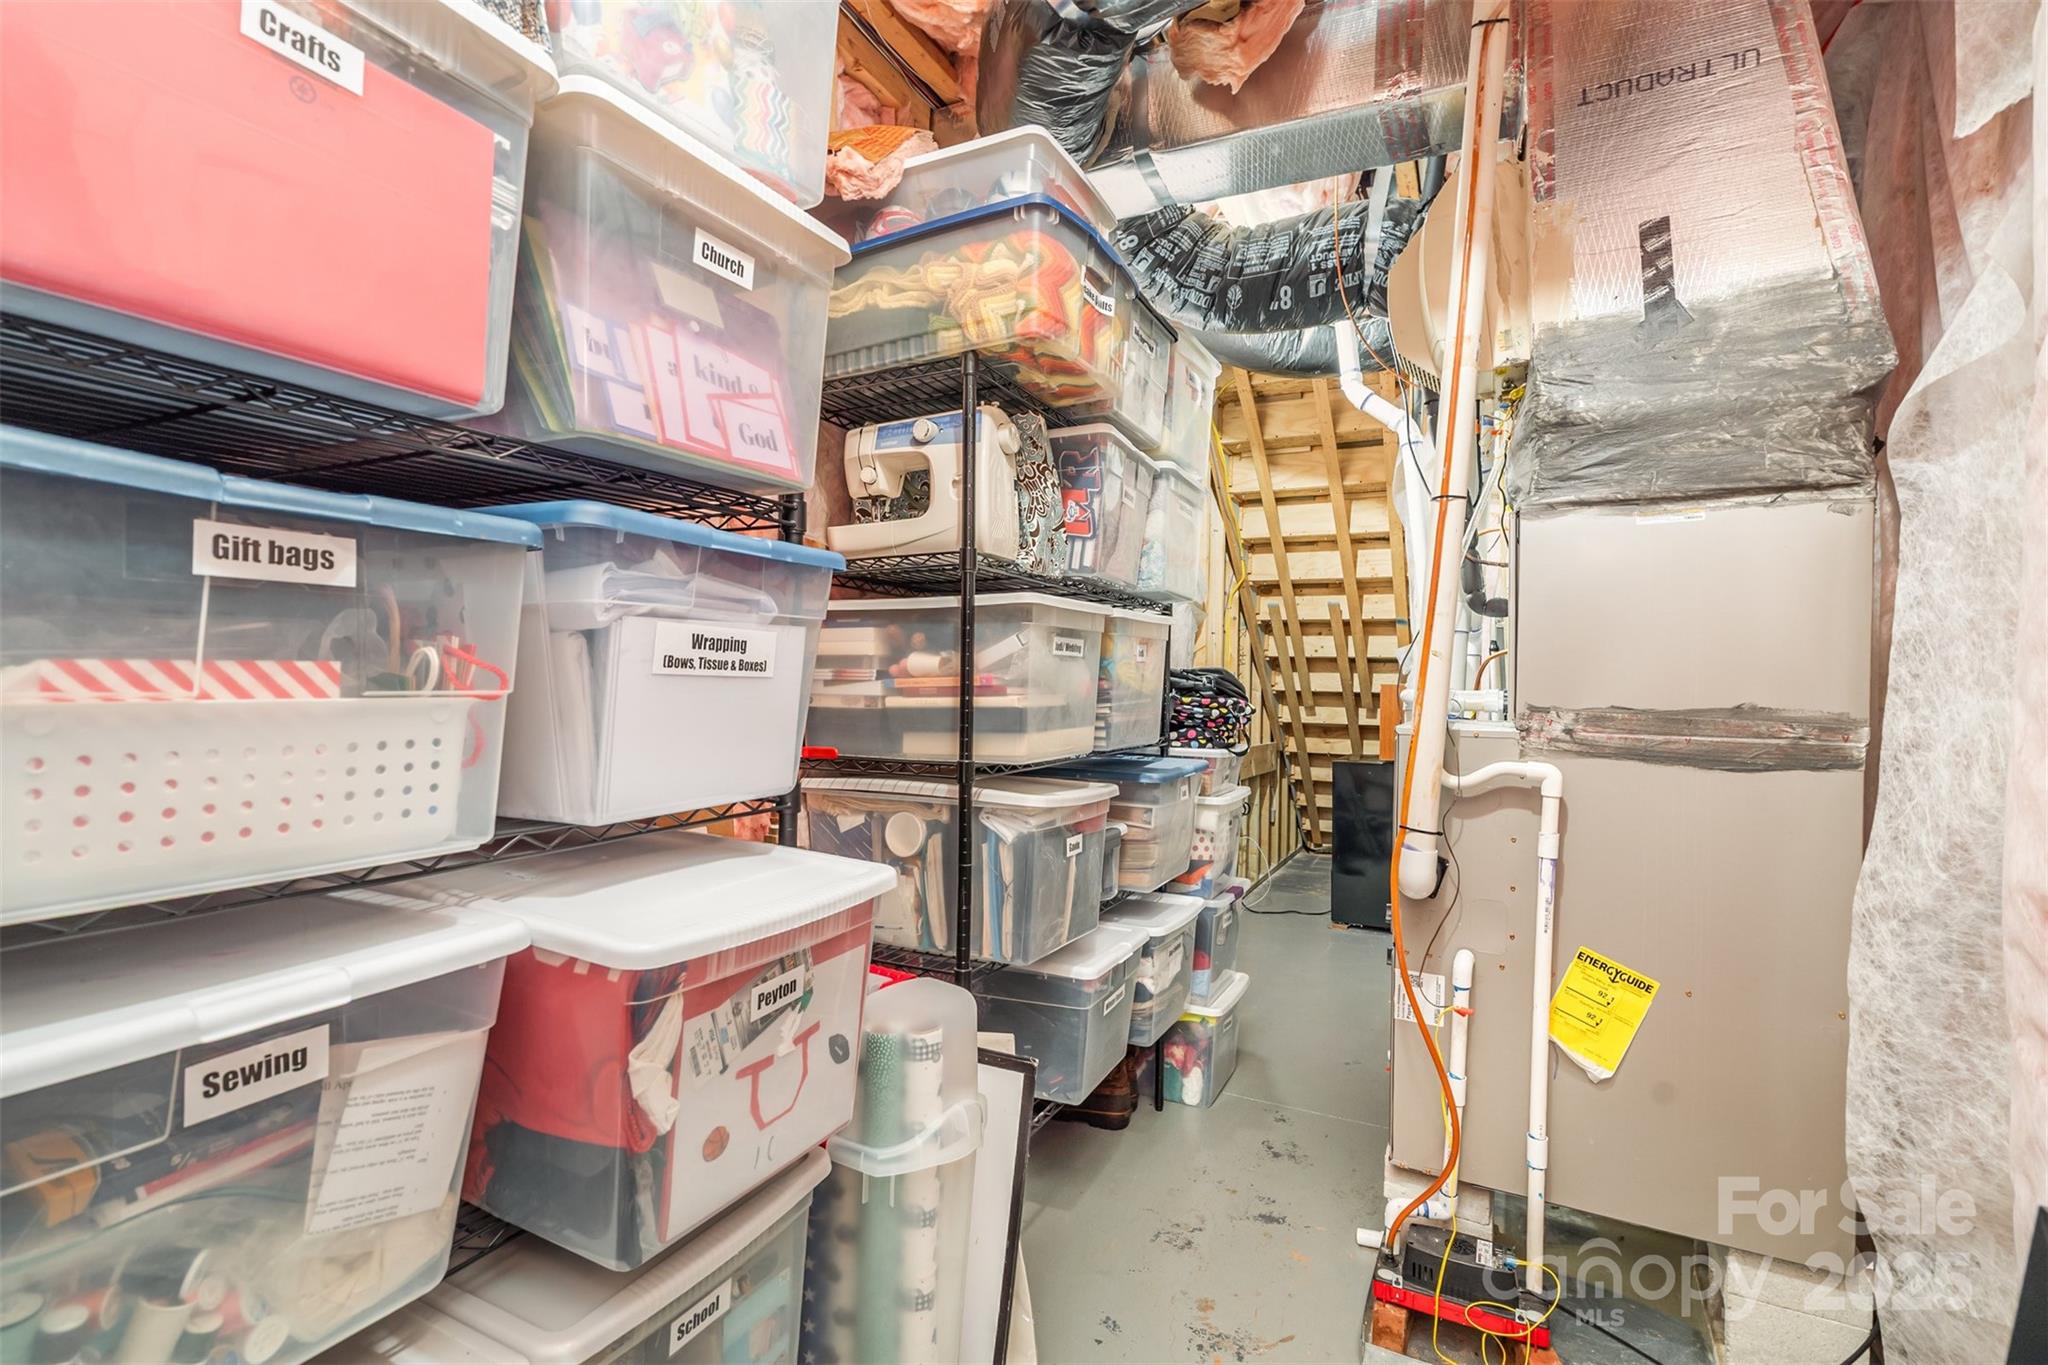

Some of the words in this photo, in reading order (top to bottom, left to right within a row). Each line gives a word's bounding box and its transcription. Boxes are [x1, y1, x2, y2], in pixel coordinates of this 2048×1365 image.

[260, 8, 341, 72] Crafts
[1577, 48, 1761, 107] ULTRADUCT
[702, 241, 745, 278] Church
[1270, 285, 1292, 311] 8"
[738, 422, 779, 453] God
[212, 533, 261, 564] Gift
[268, 540, 335, 572] bags
[691, 633, 748, 655] Wrapping
[663, 654, 697, 671] (Bows,
[698, 656, 730, 671] Tissue
[730, 660, 738, 671] &
[738, 659, 768, 673] Boxes)
[757, 978, 797, 1010] Peyton
[202, 1047, 308, 1099] Sewing
[677, 1294, 720, 1342] School
